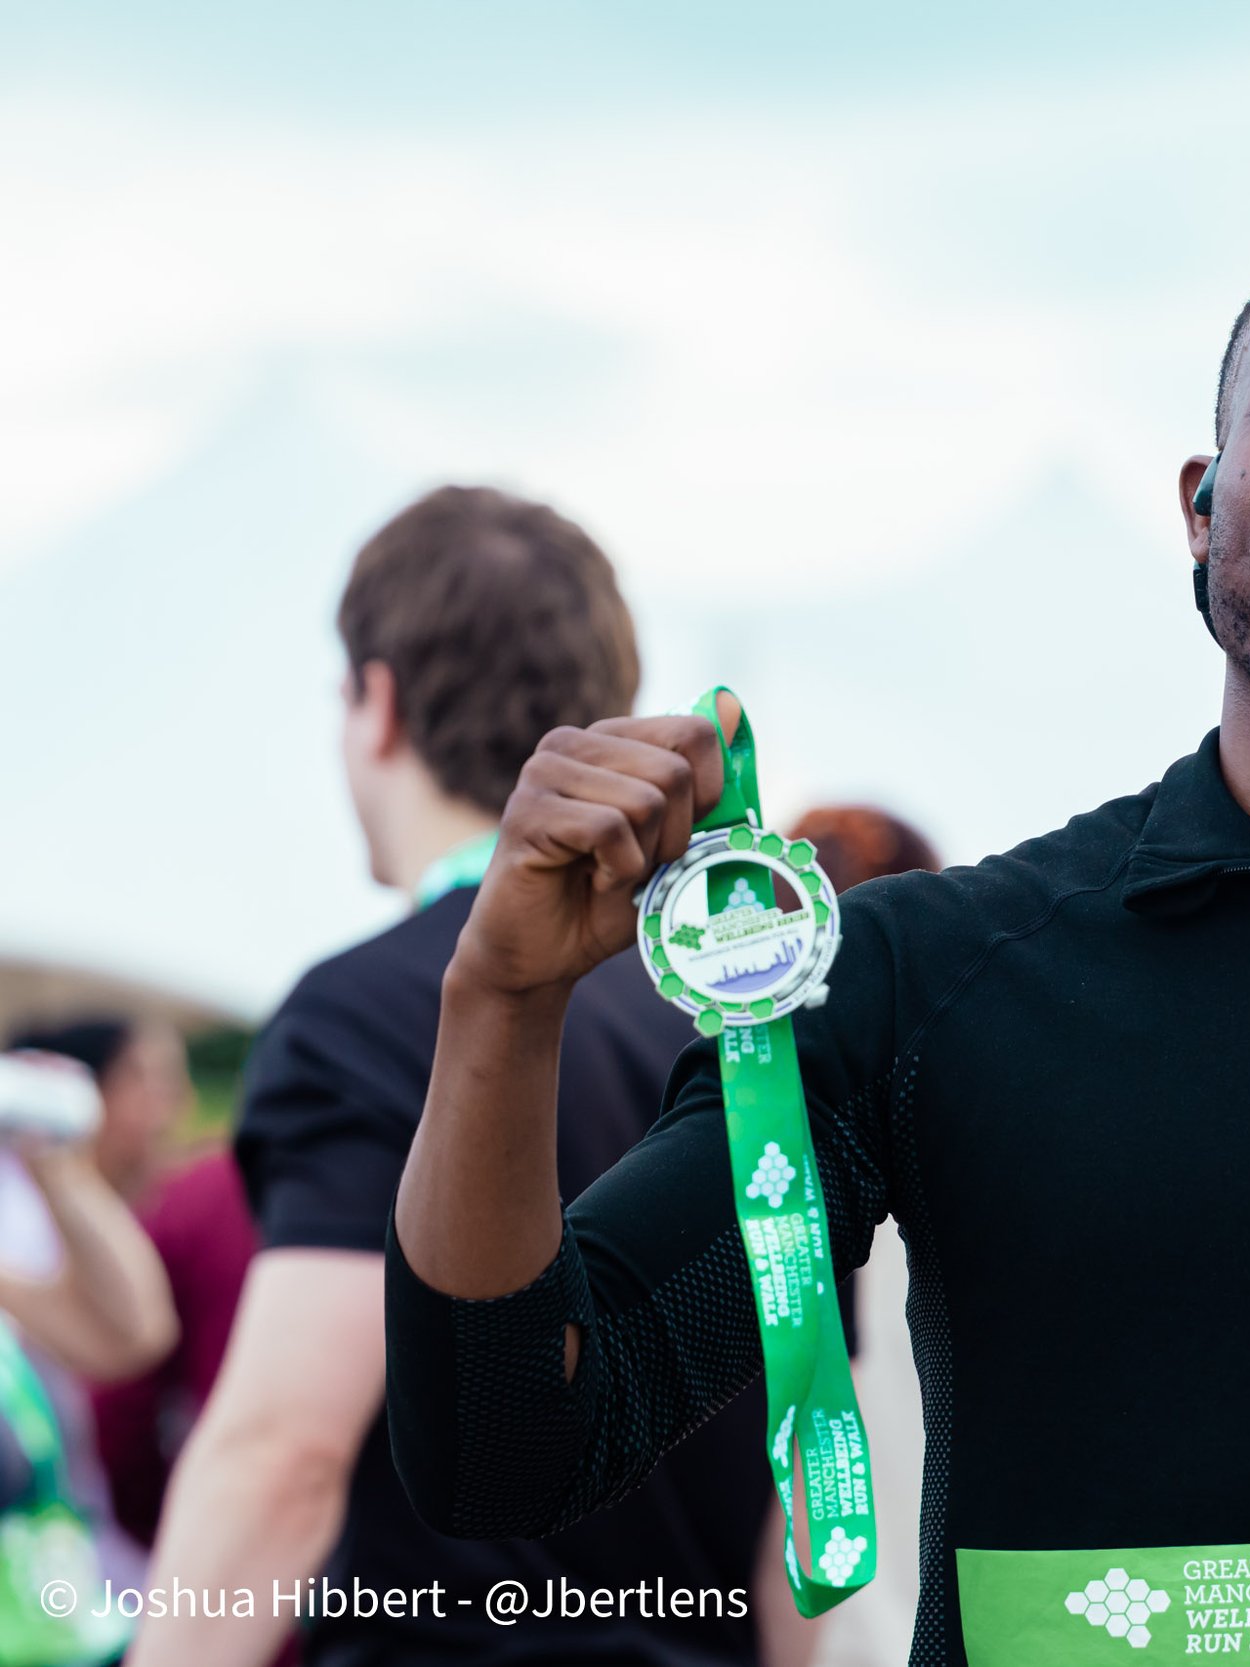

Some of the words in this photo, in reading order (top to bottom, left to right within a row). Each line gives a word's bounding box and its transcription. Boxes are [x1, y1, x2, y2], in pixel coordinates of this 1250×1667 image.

[724, 1027, 740, 1063] ALK
[746, 1219, 767, 1256] RUN
[759, 1274, 778, 1327] WALK
[762, 1218, 790, 1317] WELLBEING
[775, 1215, 803, 1328] MANCHESTER
[789, 1213, 812, 1286] GREATER
[813, 1409, 839, 1519] MANCHESTER
[829, 1419, 854, 1516] WELLBEING
[842, 1411, 864, 1458] WALK
[852, 1462, 865, 1475] &
[807, 1448, 824, 1520] GREATER
[853, 1478, 869, 1515] RUN
[1185, 1633, 1243, 1654] RUN
